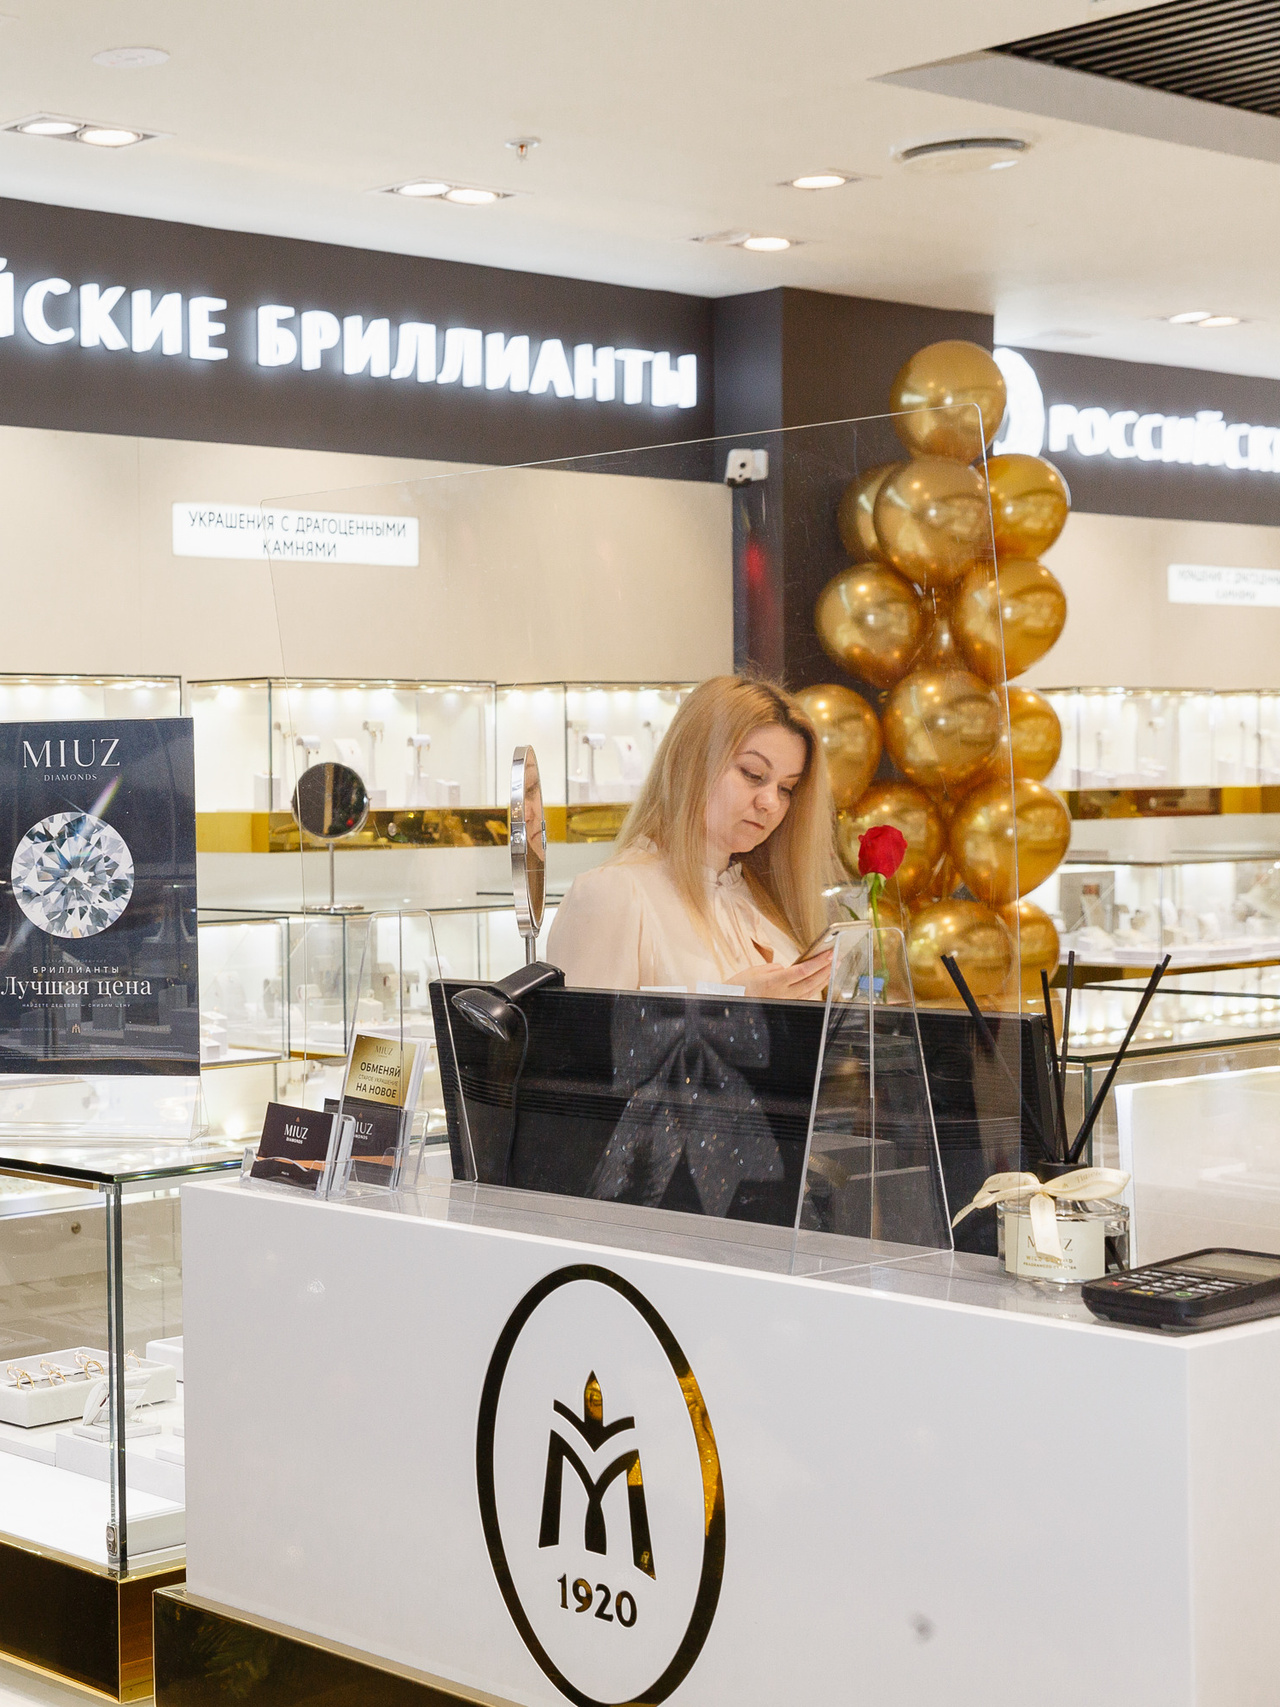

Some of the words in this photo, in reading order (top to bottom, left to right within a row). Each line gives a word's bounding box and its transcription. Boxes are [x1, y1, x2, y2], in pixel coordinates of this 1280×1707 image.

[256, 303, 699, 411] БРИЛЛИАНТЫ
[188, 511, 275, 531] УКРАШЕНИЯ
[281, 515, 289, 532] С
[295, 517, 407, 537] ДРАГОЦЕННЫМИ
[263, 540, 337, 558] КАМНЯМИ
[22, 738, 121, 768] MIUZ
[43, 773, 98, 782] DIAMONDS
[32, 966, 120, 974] БРИЛЛИАНТЫ
[0, 976, 90, 999] Лучшая
[97, 979, 153, 998] цена
[360, 1061, 401, 1078] ОБМЕНЯЙ
[356, 1082, 367, 1093] НА
[368, 1085, 397, 1098] НОВОЕ
[284, 1123, 309, 1140] MIUZ
[356, 1121, 374, 1136] IUZ
[1027, 1235, 1074, 1252] MZ
[557, 1573, 638, 1628] 1920
